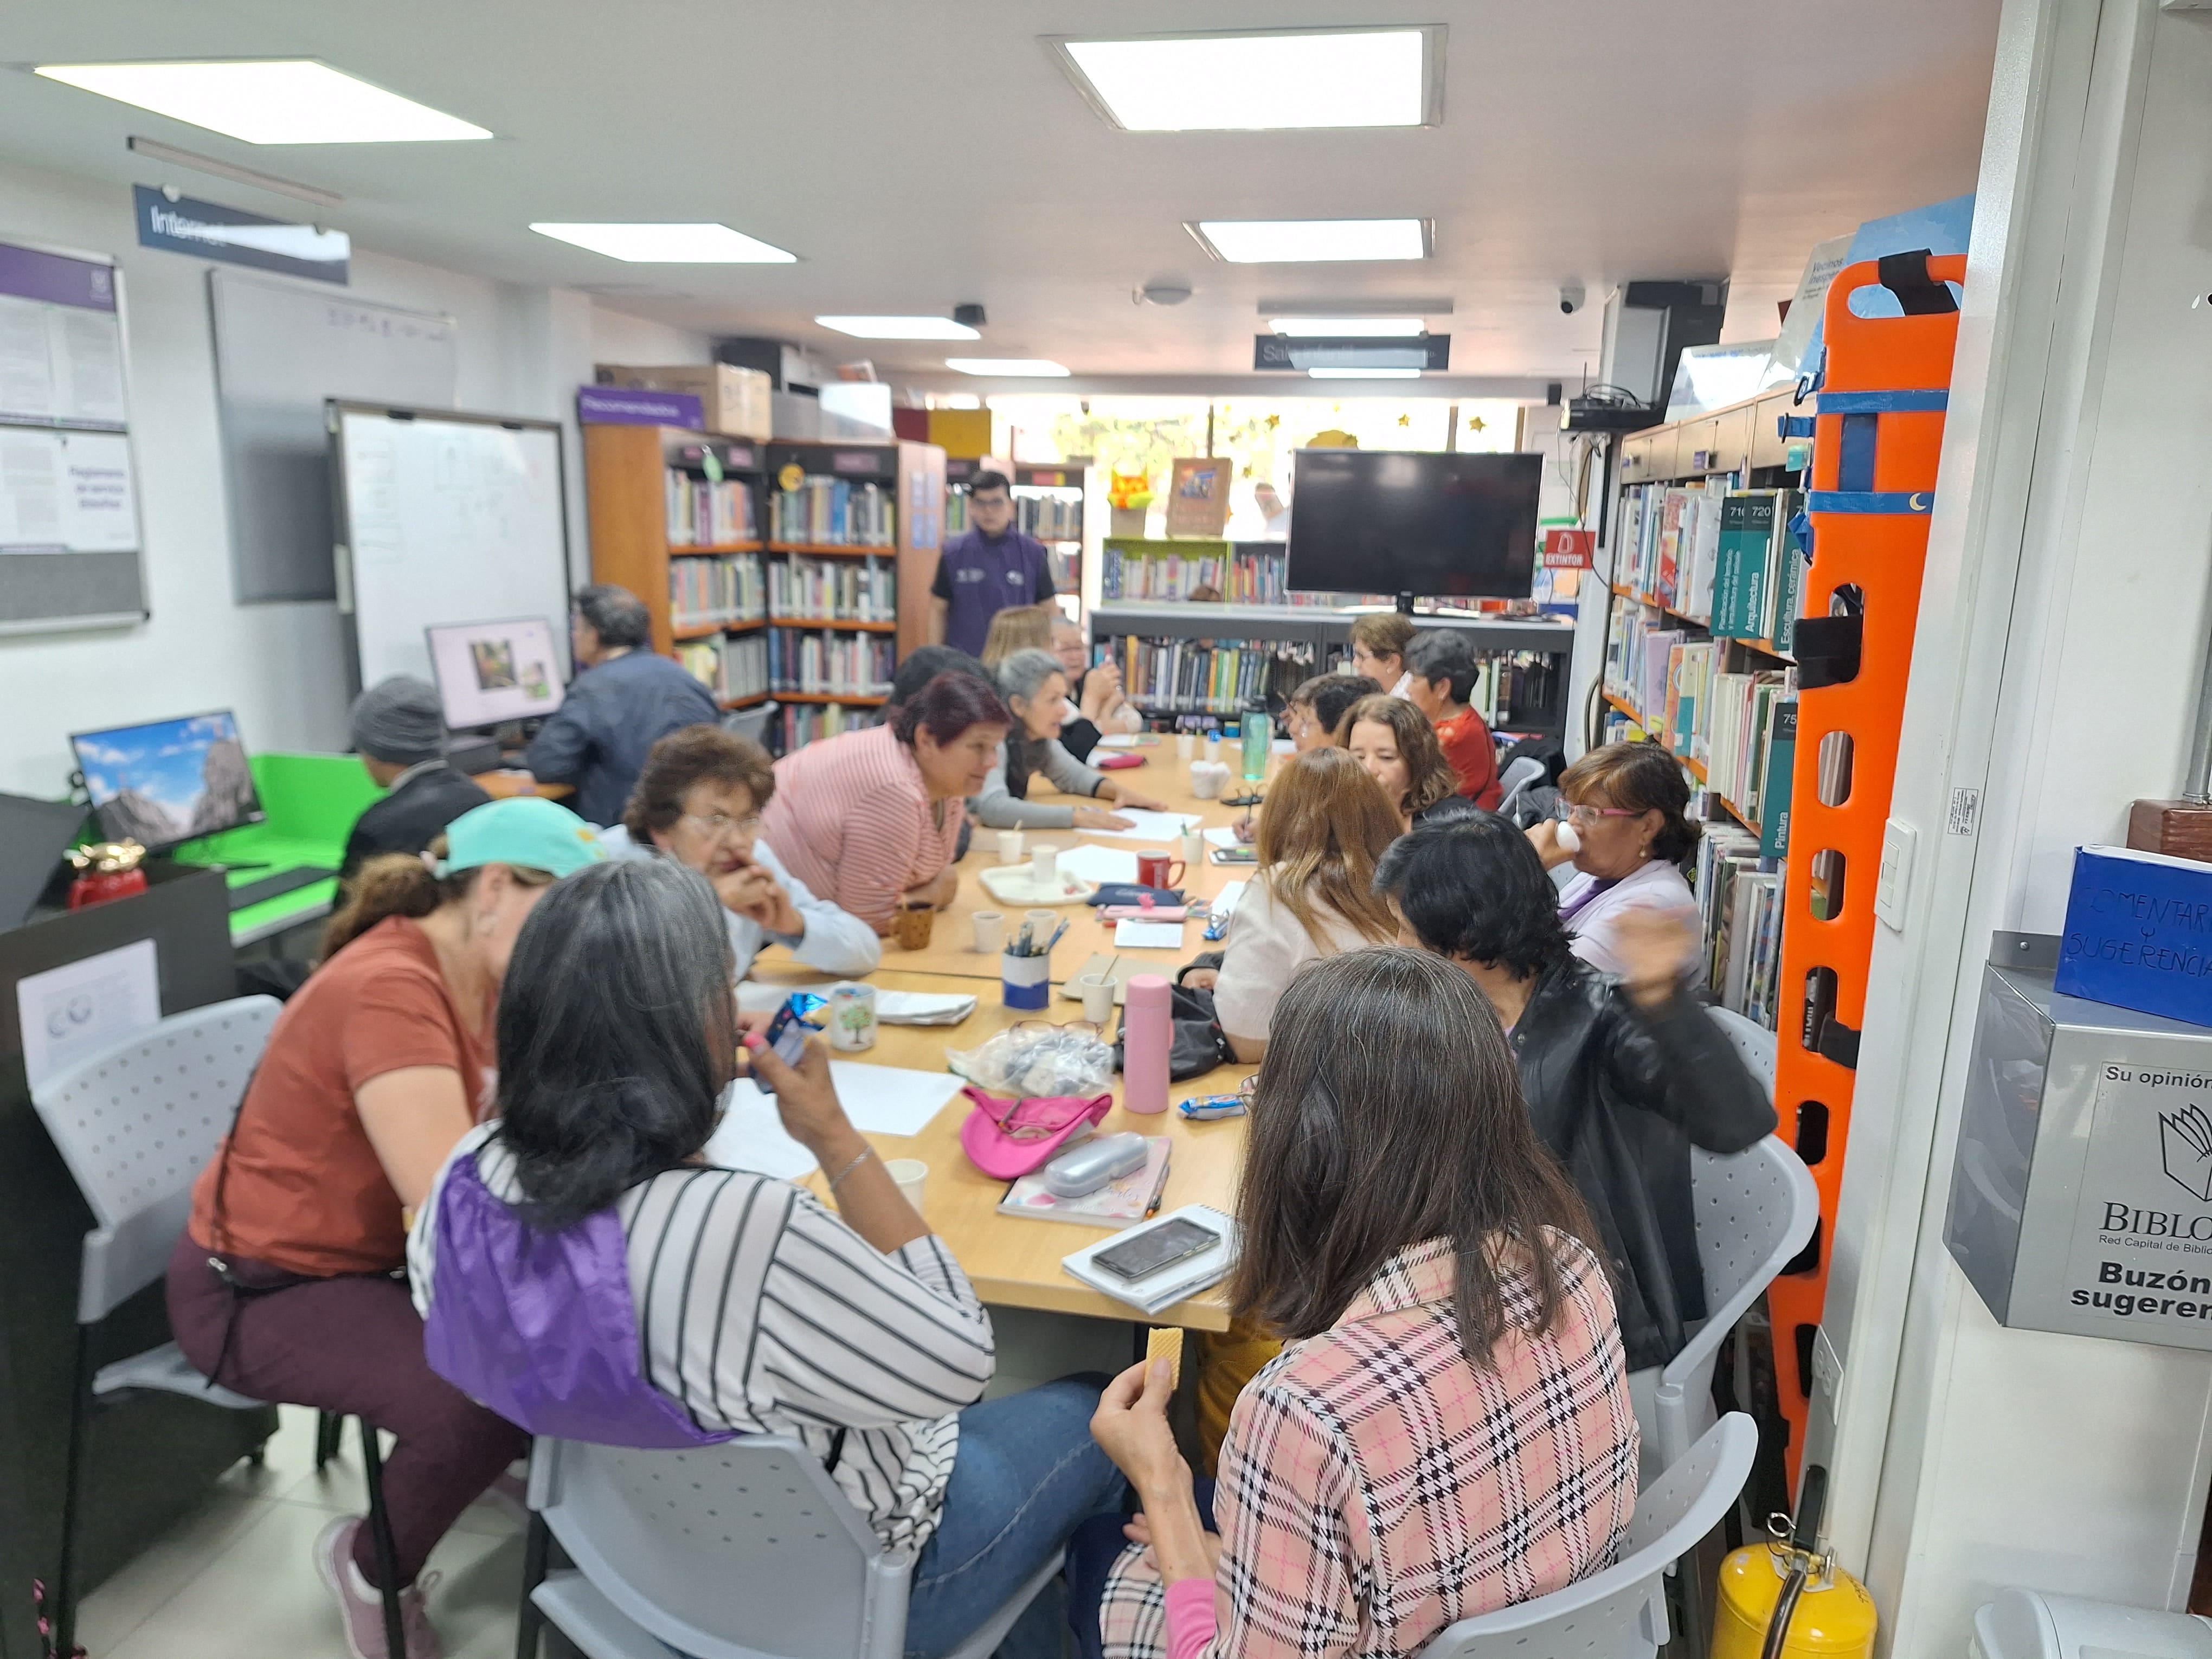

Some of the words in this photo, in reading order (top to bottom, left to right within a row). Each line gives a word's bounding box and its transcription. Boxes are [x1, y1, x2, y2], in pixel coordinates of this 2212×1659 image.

[1752, 506, 1771, 517] 720
[1545, 552, 1584, 567] EXTINTOR
[1787, 549, 1800, 595] cerámica
[1745, 572, 1759, 633] Arquitectura
[1774, 812, 1789, 849] Pintura
[2105, 1066, 2132, 1082] Su
[2139, 1071, 2212, 1089] opinión
[2099, 1234, 2121, 1245] Red
[2124, 1237, 2163, 1250] Capital
[2166, 1242, 2179, 1251] de
[2098, 1261, 2211, 1295] Buzón
